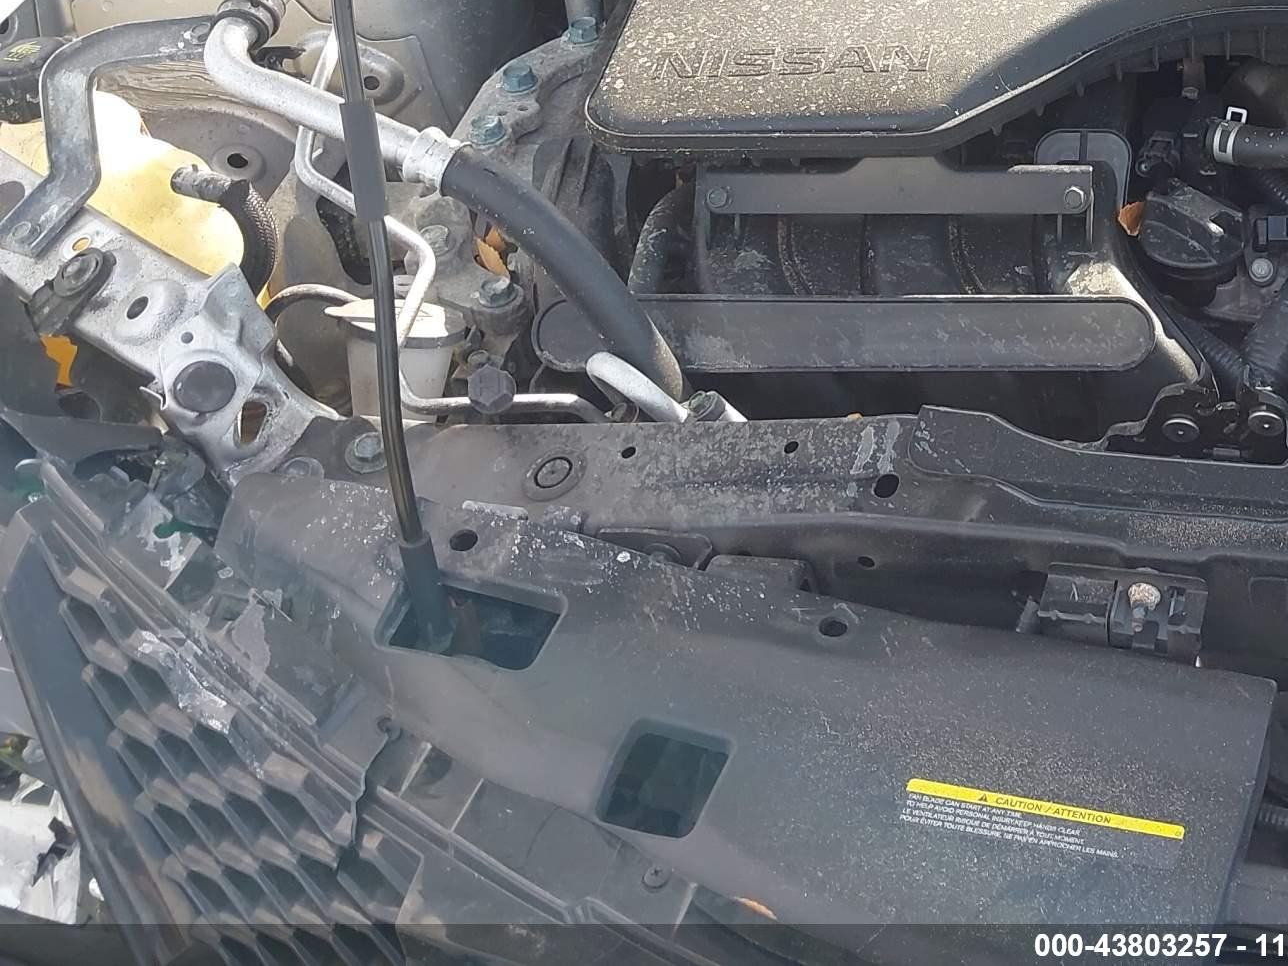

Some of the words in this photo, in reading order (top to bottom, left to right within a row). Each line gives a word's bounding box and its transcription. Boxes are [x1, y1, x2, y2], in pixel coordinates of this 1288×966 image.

[651, 43, 933, 81] NISSAN
[916, 801, 932, 809] HELP
[934, 804, 954, 813] AVOID
[956, 808, 989, 819] PERSONAL
[960, 802, 979, 810] START
[995, 797, 1043, 812] CAUTION
[1053, 808, 1112, 824] ATTENTION
[899, 814, 918, 822] POUR
[943, 821, 963, 830] TOUTE
[1082, 845, 1094, 853] LES
